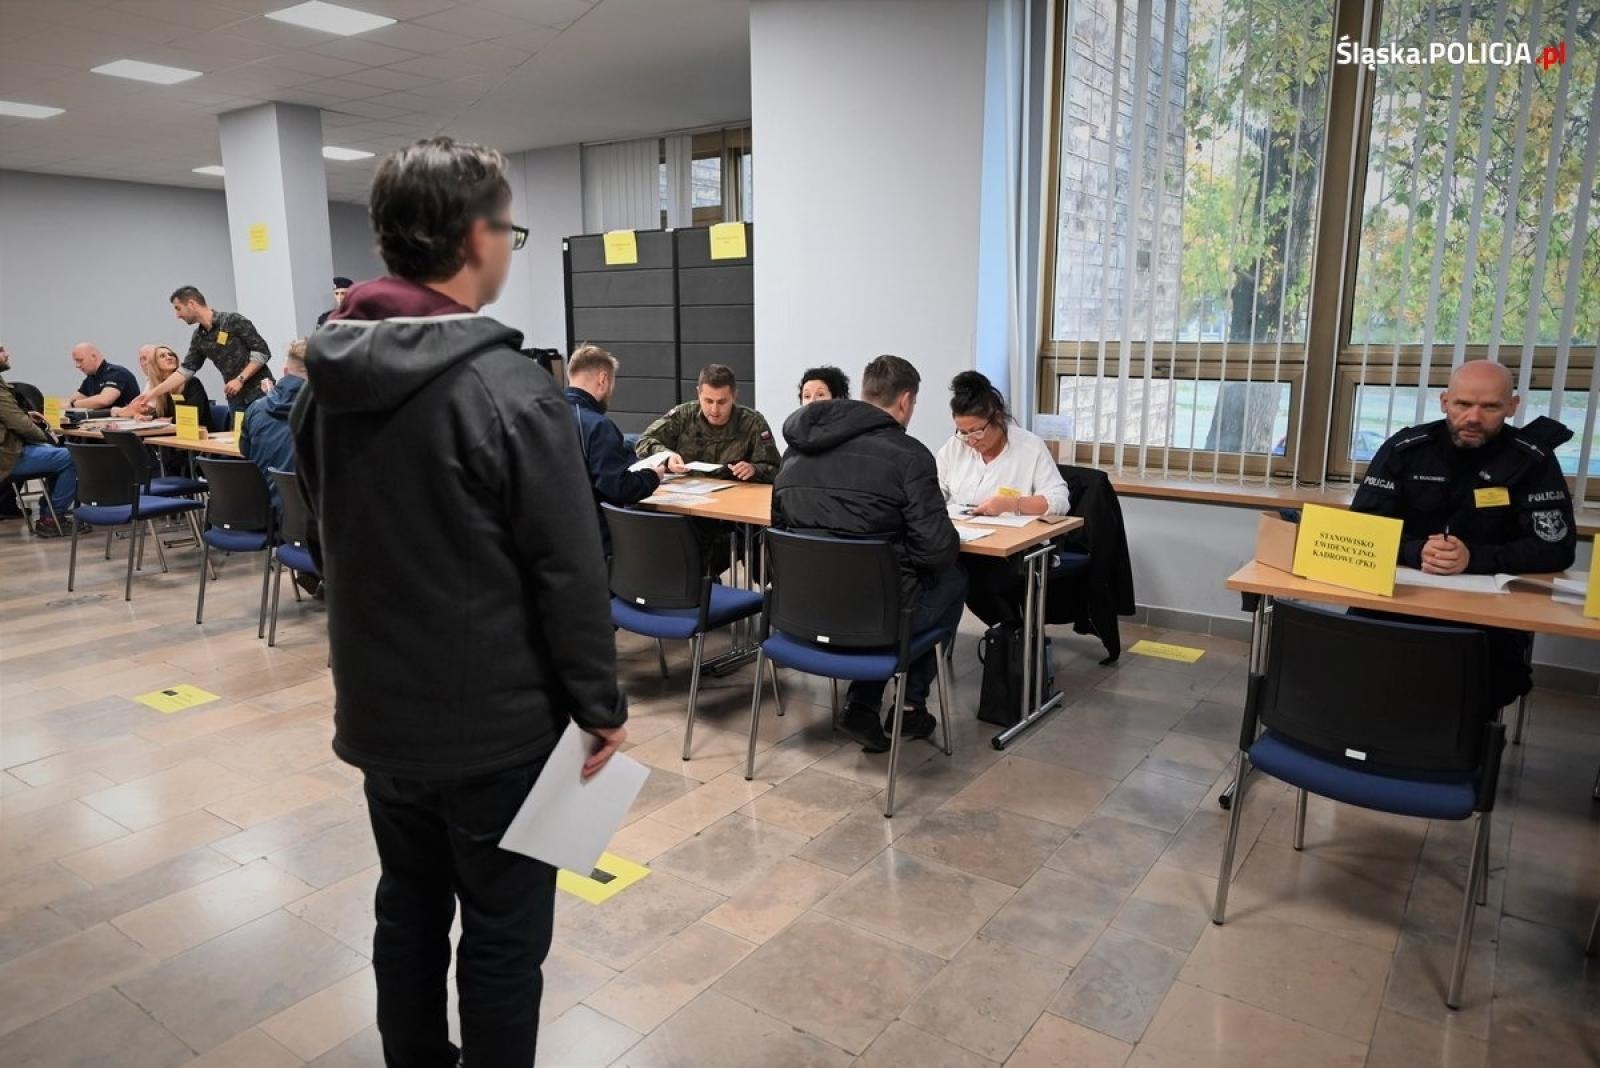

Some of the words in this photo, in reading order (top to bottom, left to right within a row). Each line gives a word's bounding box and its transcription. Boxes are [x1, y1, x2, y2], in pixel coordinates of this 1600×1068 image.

[1363, 476, 1394, 490] POLICJA
[1528, 490, 1565, 502] POLICJA
[1320, 532, 1374, 549] STANOWISKO
[1312, 549, 1354, 564] KADROWE
[1314, 540, 1376, 558] EWIDENCYJNO-
